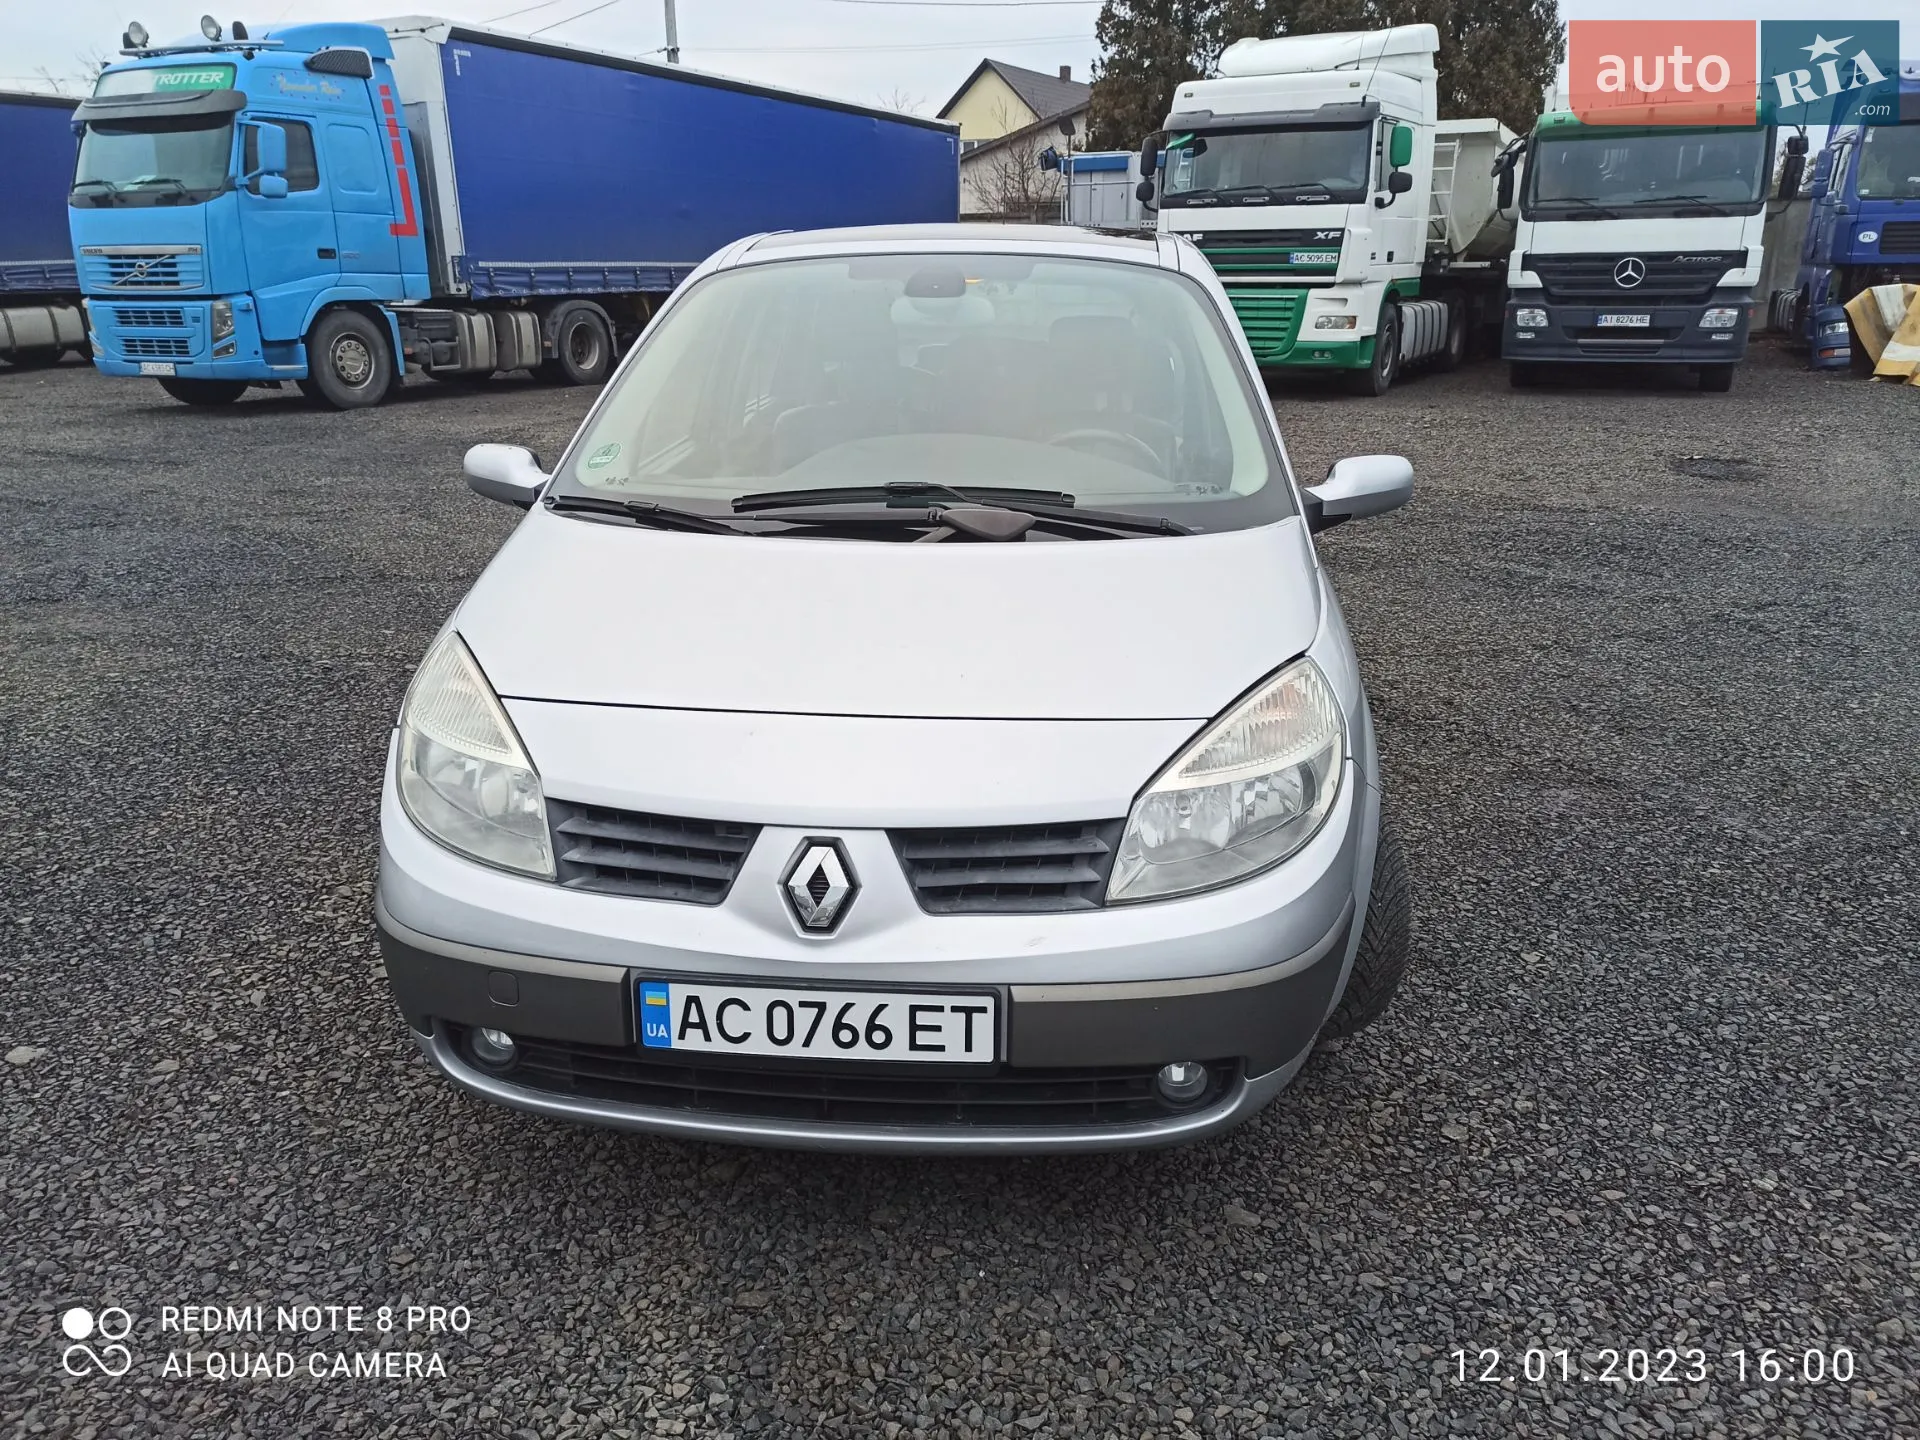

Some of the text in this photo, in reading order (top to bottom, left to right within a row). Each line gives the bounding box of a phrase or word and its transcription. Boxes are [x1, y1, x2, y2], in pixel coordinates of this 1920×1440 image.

[1182, 233, 1203, 242] AF
[1294, 254, 1337, 263] AC 5095 EM
[1635, 315, 1647, 324] HE
[677, 994, 988, 1053] AC 0766 ET
[646, 1023, 669, 1039] UA
